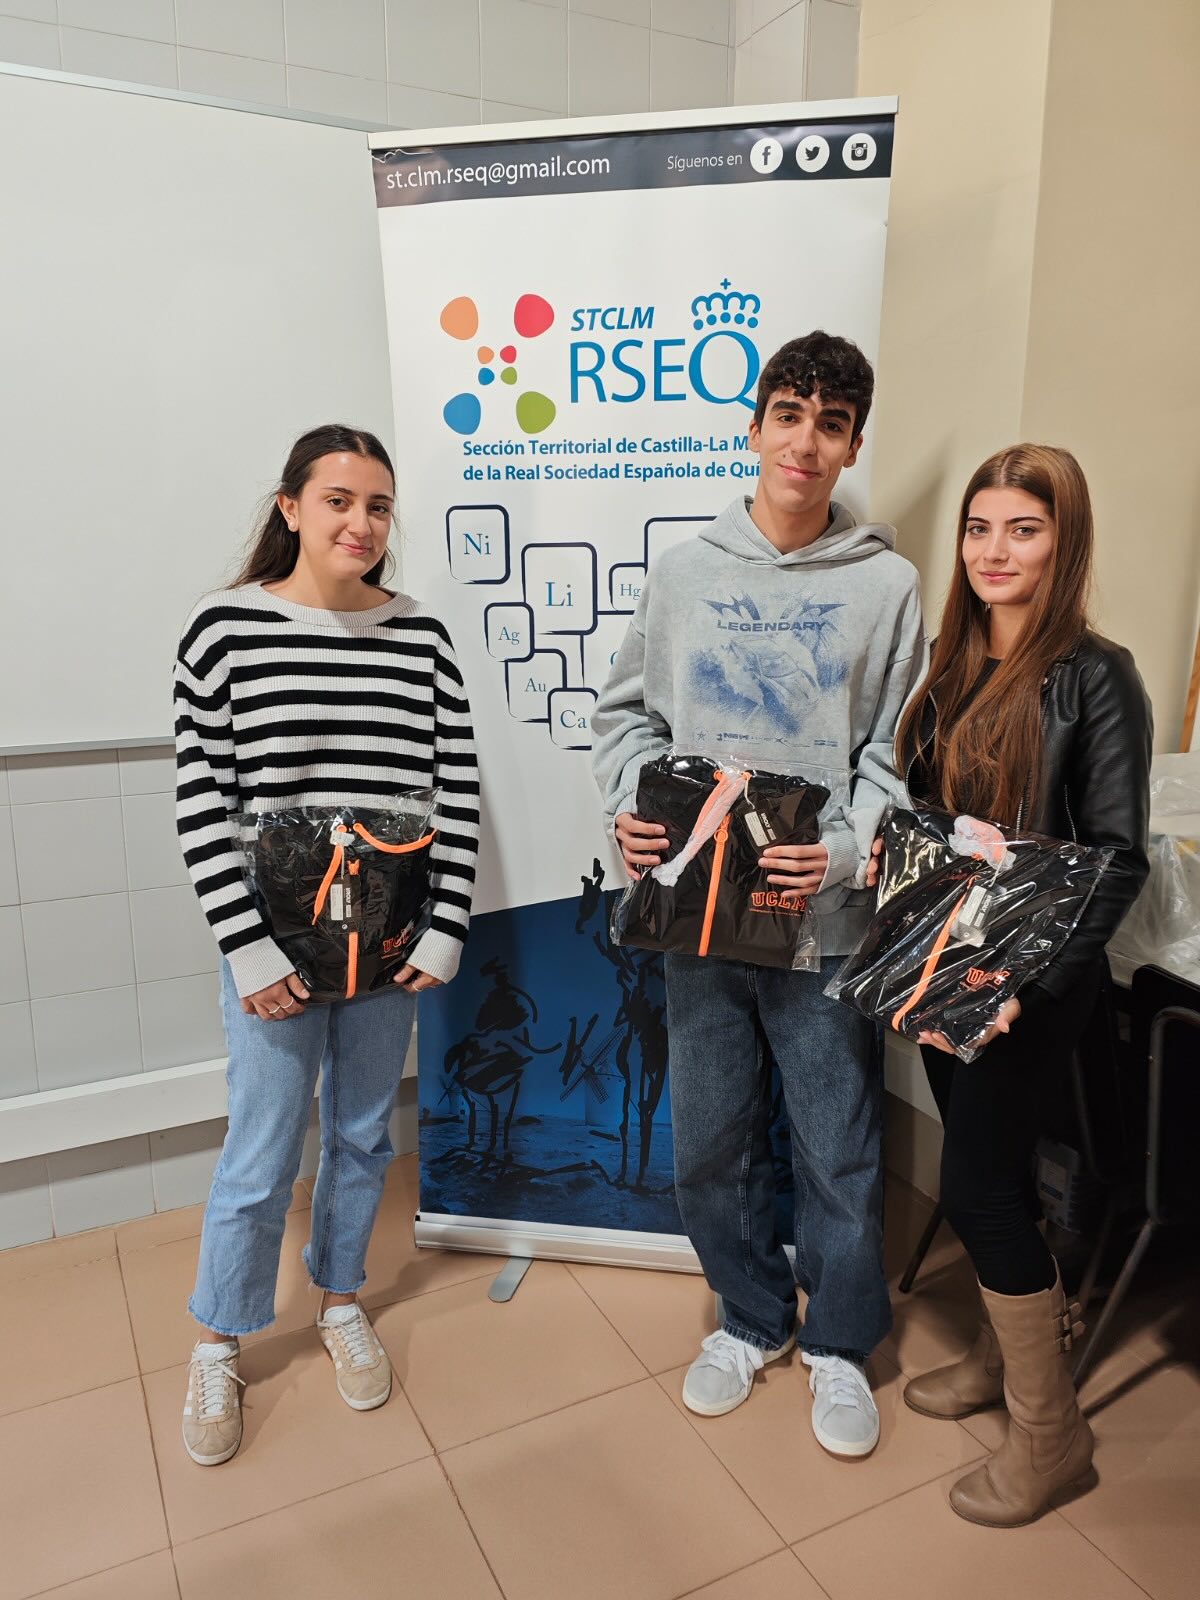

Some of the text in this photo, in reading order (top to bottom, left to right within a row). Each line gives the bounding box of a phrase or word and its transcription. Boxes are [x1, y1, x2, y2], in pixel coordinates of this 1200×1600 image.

[386, 155, 611, 189] st.clm.rseq@gmail.com
[667, 154, 743, 172] Síguenos en
[570, 306, 655, 332] STCLM
[570, 330, 761, 411] RSEQ
[463, 435, 749, 456] Sección Territorial de Castilla-La M
[463, 461, 760, 483] de la Real Sociedad Española de Quí
[463, 533, 492, 555] Ni
[545, 582, 574, 607] Li
[619, 584, 642, 598] Hg
[497, 626, 520, 646] Ag
[716, 619, 826, 632] LEGENDARY
[524, 677, 547, 692] Au
[559, 709, 588, 729] Ca
[751, 891, 807, 912] UCLM
